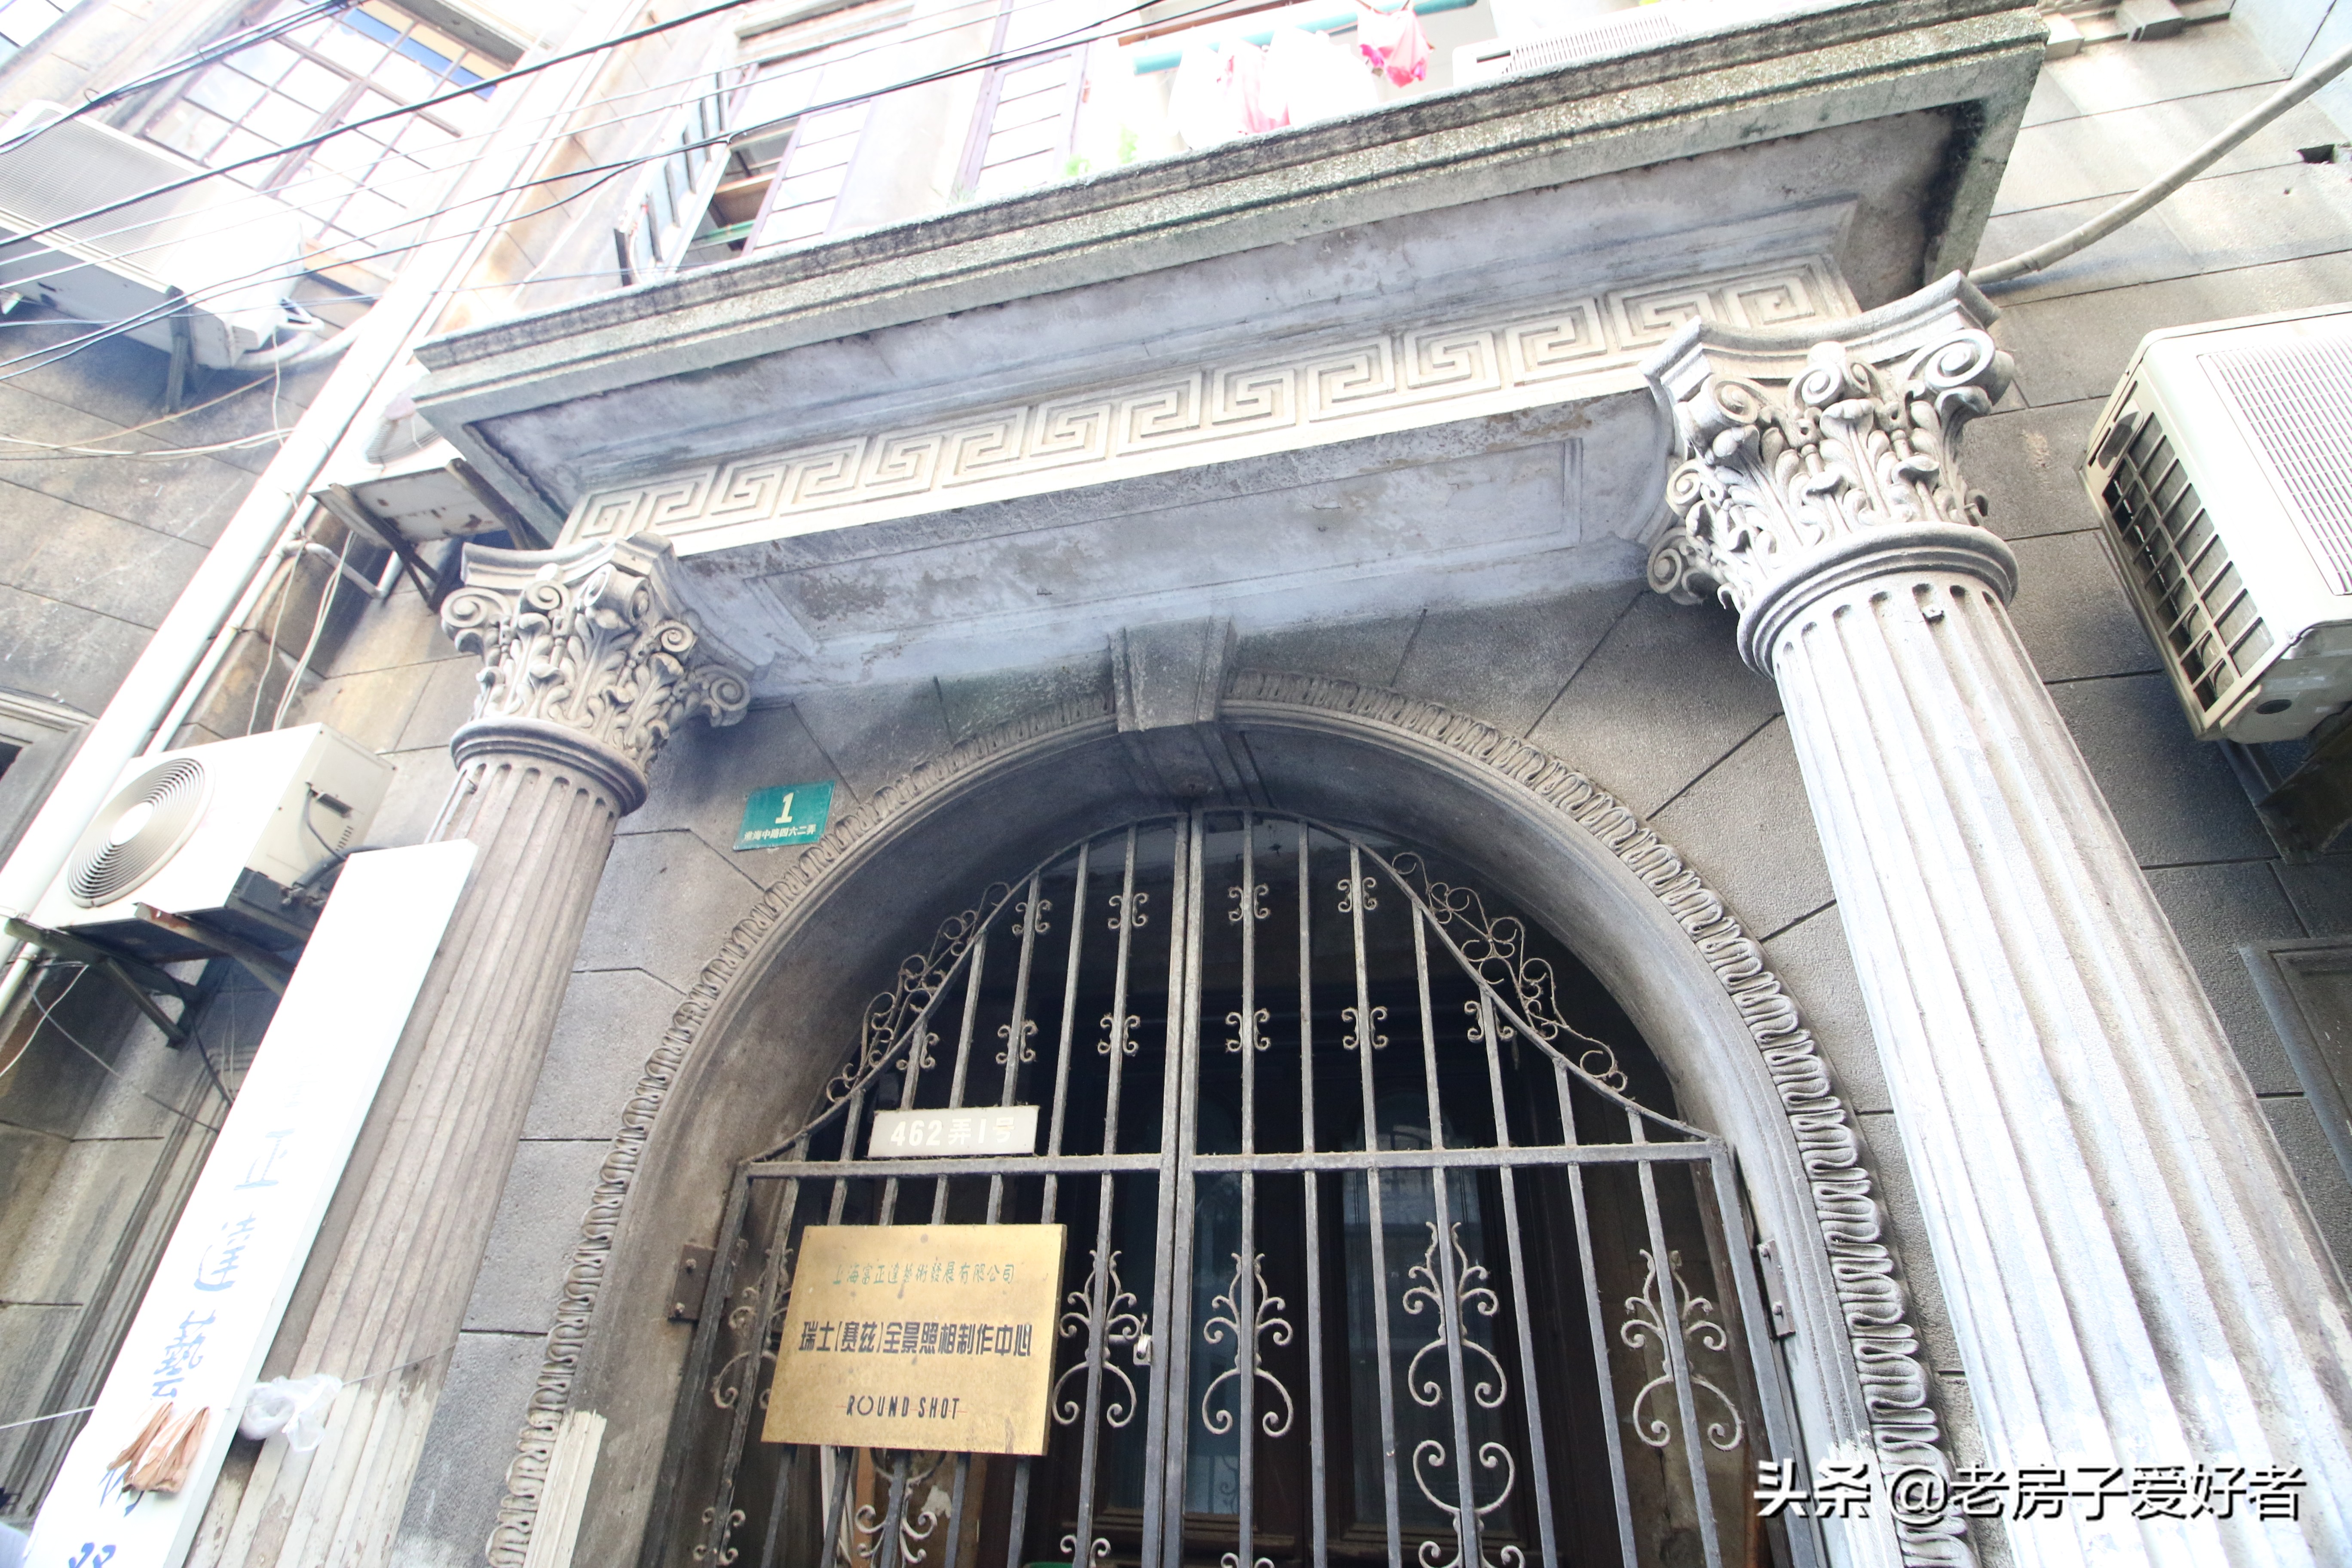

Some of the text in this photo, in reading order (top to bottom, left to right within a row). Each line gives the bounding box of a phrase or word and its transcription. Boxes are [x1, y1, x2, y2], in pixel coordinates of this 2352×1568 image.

[775, 792, 794, 824] 1
[890, 1117, 1015, 1147] 462弄1号
[846, 1395, 960, 1420] ROUND SHOT
